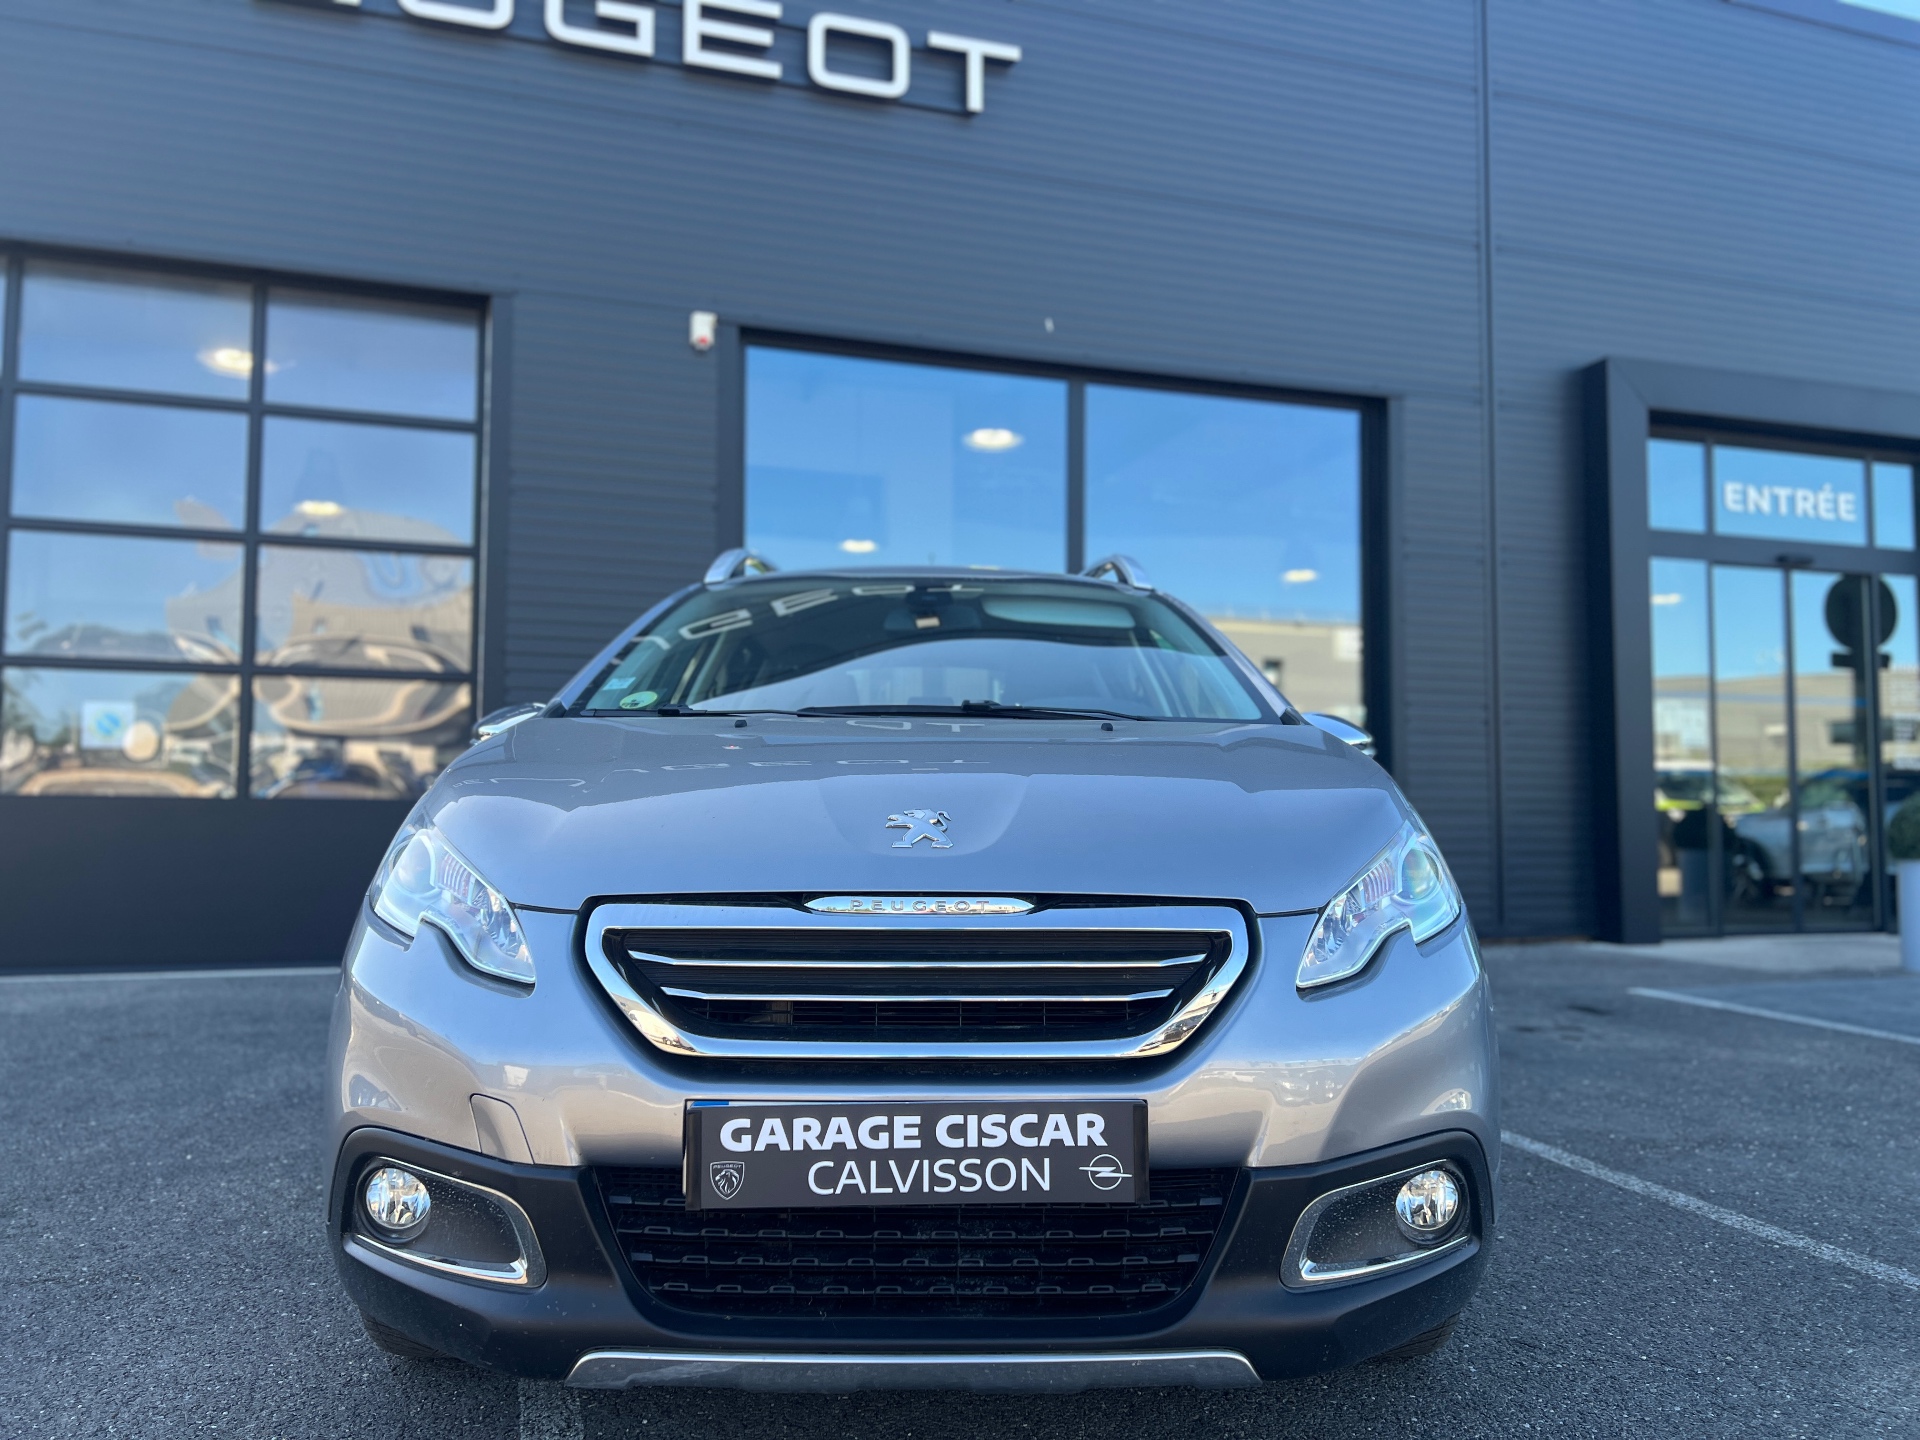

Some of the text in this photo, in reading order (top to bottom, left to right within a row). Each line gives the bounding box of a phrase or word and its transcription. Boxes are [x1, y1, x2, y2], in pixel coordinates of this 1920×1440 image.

[332, 0, 1022, 113] GEOT
[1723, 482, 1857, 522] ENTRÉE
[850, 899, 990, 912] PEUGEOT
[719, 1113, 1107, 1152] GARAGE CISCAR
[807, 1157, 1050, 1195] CALVISSON
